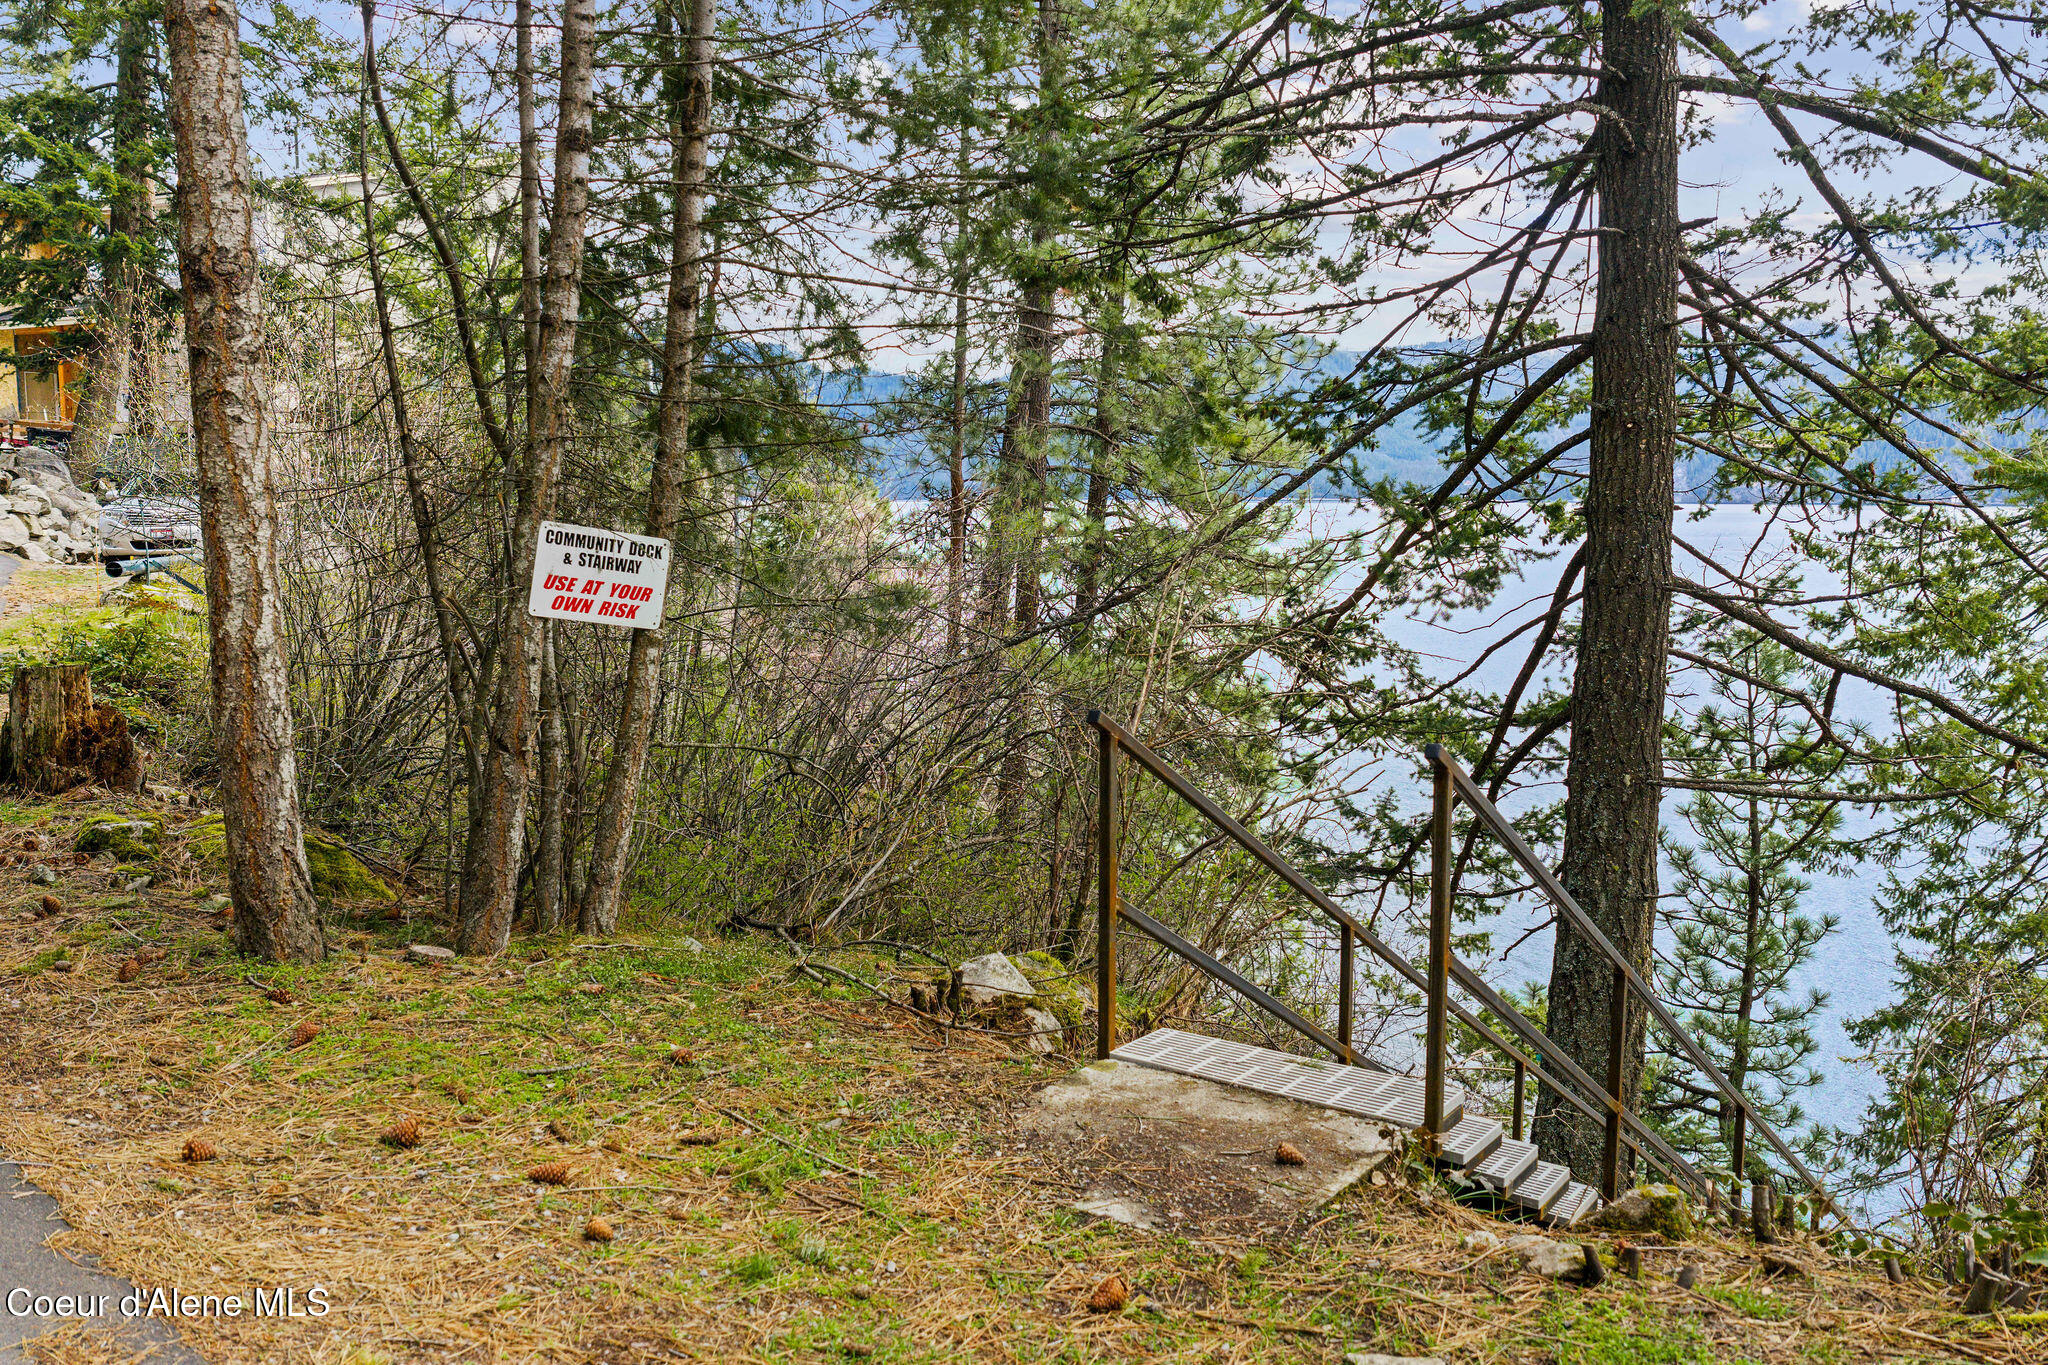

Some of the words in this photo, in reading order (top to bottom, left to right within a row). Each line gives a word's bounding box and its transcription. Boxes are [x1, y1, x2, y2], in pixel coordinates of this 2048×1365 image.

[546, 530, 624, 553] COMMUNITY
[629, 542, 663, 559] DOCK
[563, 553, 572, 565] &
[579, 553, 642, 574] STAIRWAY
[544, 574, 578, 592] USE
[581, 580, 604, 595] AT
[610, 583, 653, 602] YOUR
[551, 596, 594, 613] OWN
[598, 601, 640, 619] RISK
